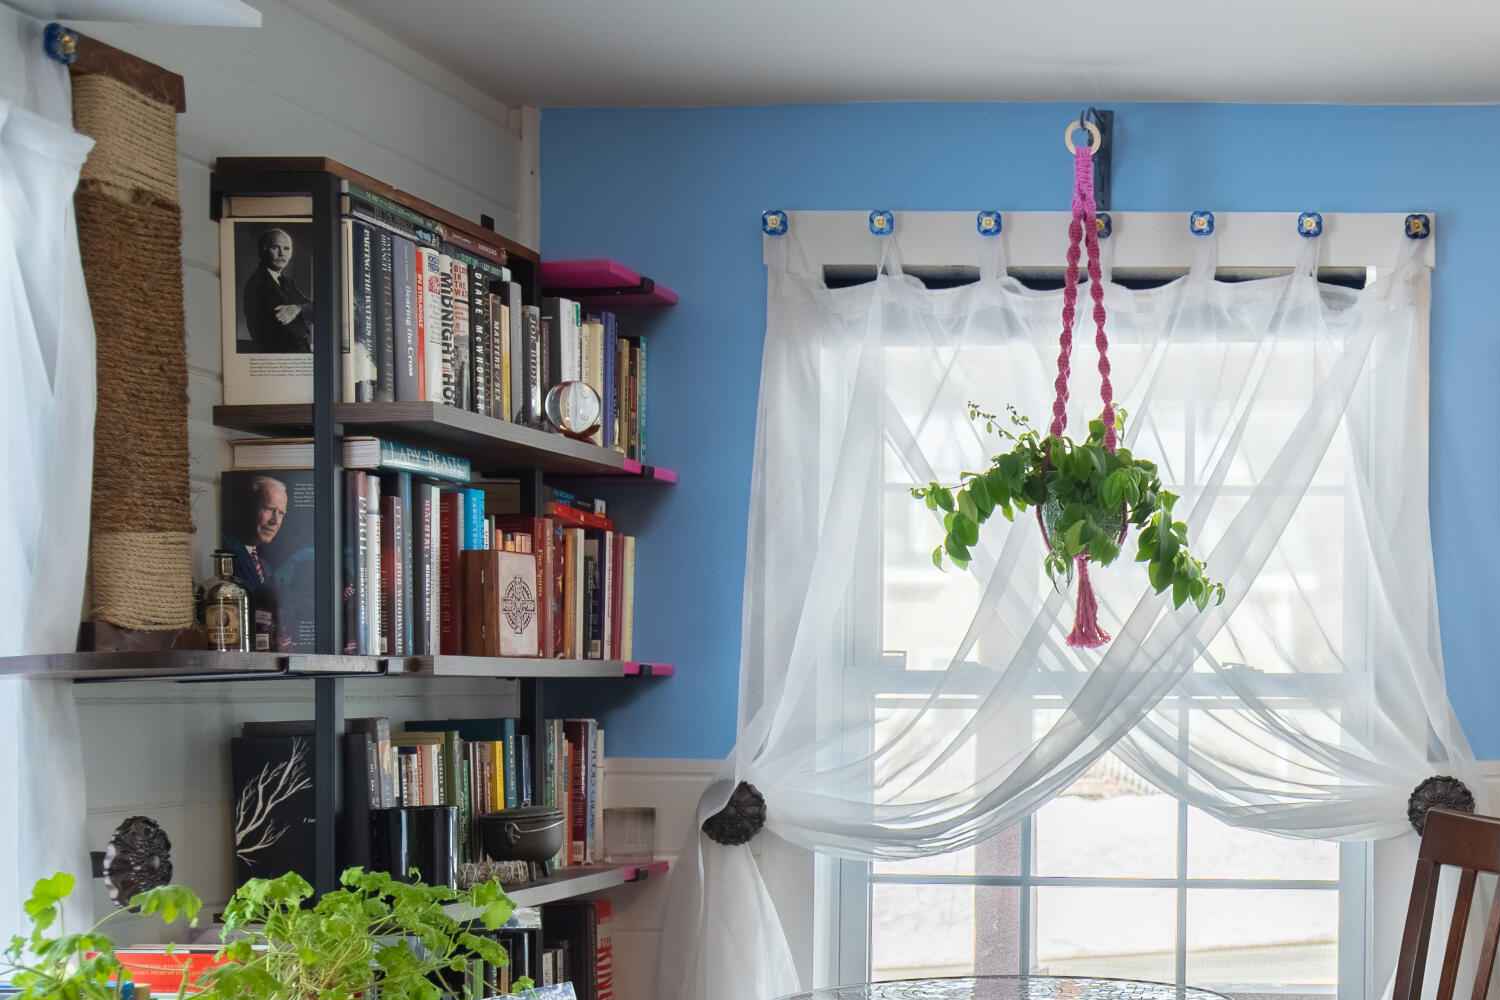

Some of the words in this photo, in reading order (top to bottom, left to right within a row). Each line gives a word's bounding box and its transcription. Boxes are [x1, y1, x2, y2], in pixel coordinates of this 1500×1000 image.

[363, 229, 371, 270] PARTING
[417, 273, 423, 283] IN
[474, 272, 483, 315] DIANE
[405, 285, 413, 326] Bearing
[441, 272, 454, 367] MIDNIGHT
[529, 317, 537, 343] JOE
[475, 325, 484, 410] McWHORTER
[359, 496, 368, 555] PERIL
